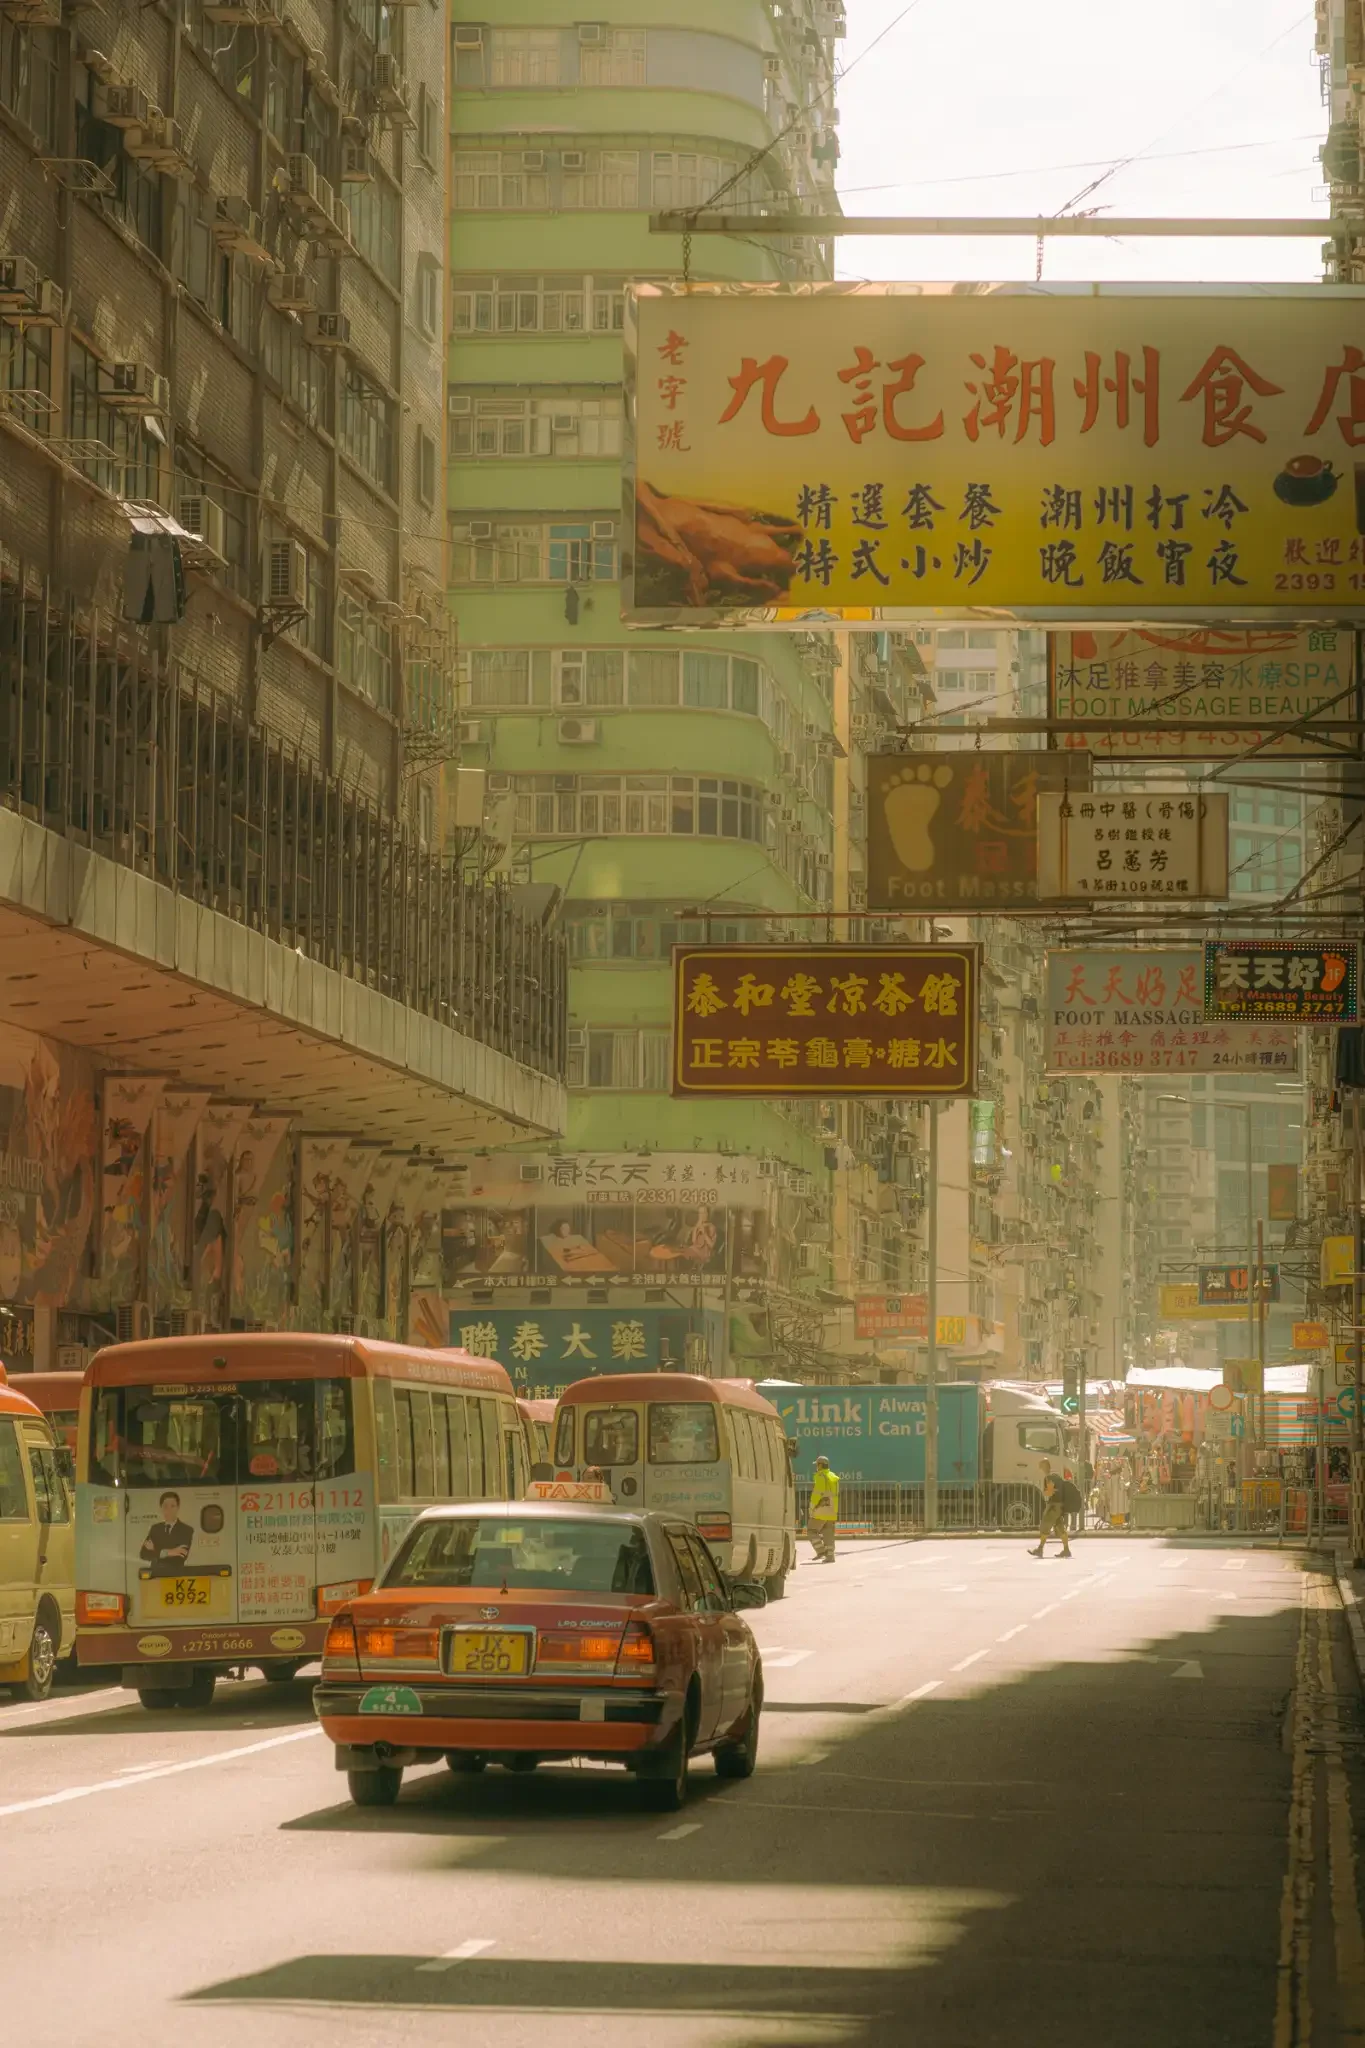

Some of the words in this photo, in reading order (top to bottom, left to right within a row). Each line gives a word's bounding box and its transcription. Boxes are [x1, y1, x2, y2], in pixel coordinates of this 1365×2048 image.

[656, 328, 692, 452] 老字號
[796, 482, 1004, 531] 精選套餐
[1040, 483, 1250, 533] 潮州打冷
[796, 538, 994, 587] 特式小炒
[1039, 539, 1251, 588] 晚飯宵夜
[1274, 573, 1336, 591] 2393
[1057, 698, 1122, 718] FOOT
[1128, 696, 1242, 717] MASSAGE
[1249, 696, 1339, 716] BEAUTY
[887, 875, 946, 898] Foot
[1218, 956, 1320, 991] 天天好
[1247, 991, 1299, 1002] Massage
[1301, 1002, 1345, 1013] 3747
[1053, 1010, 1105, 1026] FOOT
[1149, 1050, 1198, 1067] 3747
[680, 1189, 718, 1204] 2186
[459, 1320, 649, 1362] 聯泰大藥
[796, 1426, 862, 1437] LOGISTICS
[879, 1421, 911, 1437] Can
[316, 1489, 364, 1508] 1112
[534, 1483, 602, 1499] TAXI
[175, 1579, 197, 1592] KZ
[164, 1591, 208, 1605] 8992
[189, 1641, 218, 1653] 2751
[222, 1639, 254, 1651] 6666
[477, 1635, 505, 1653] JX
